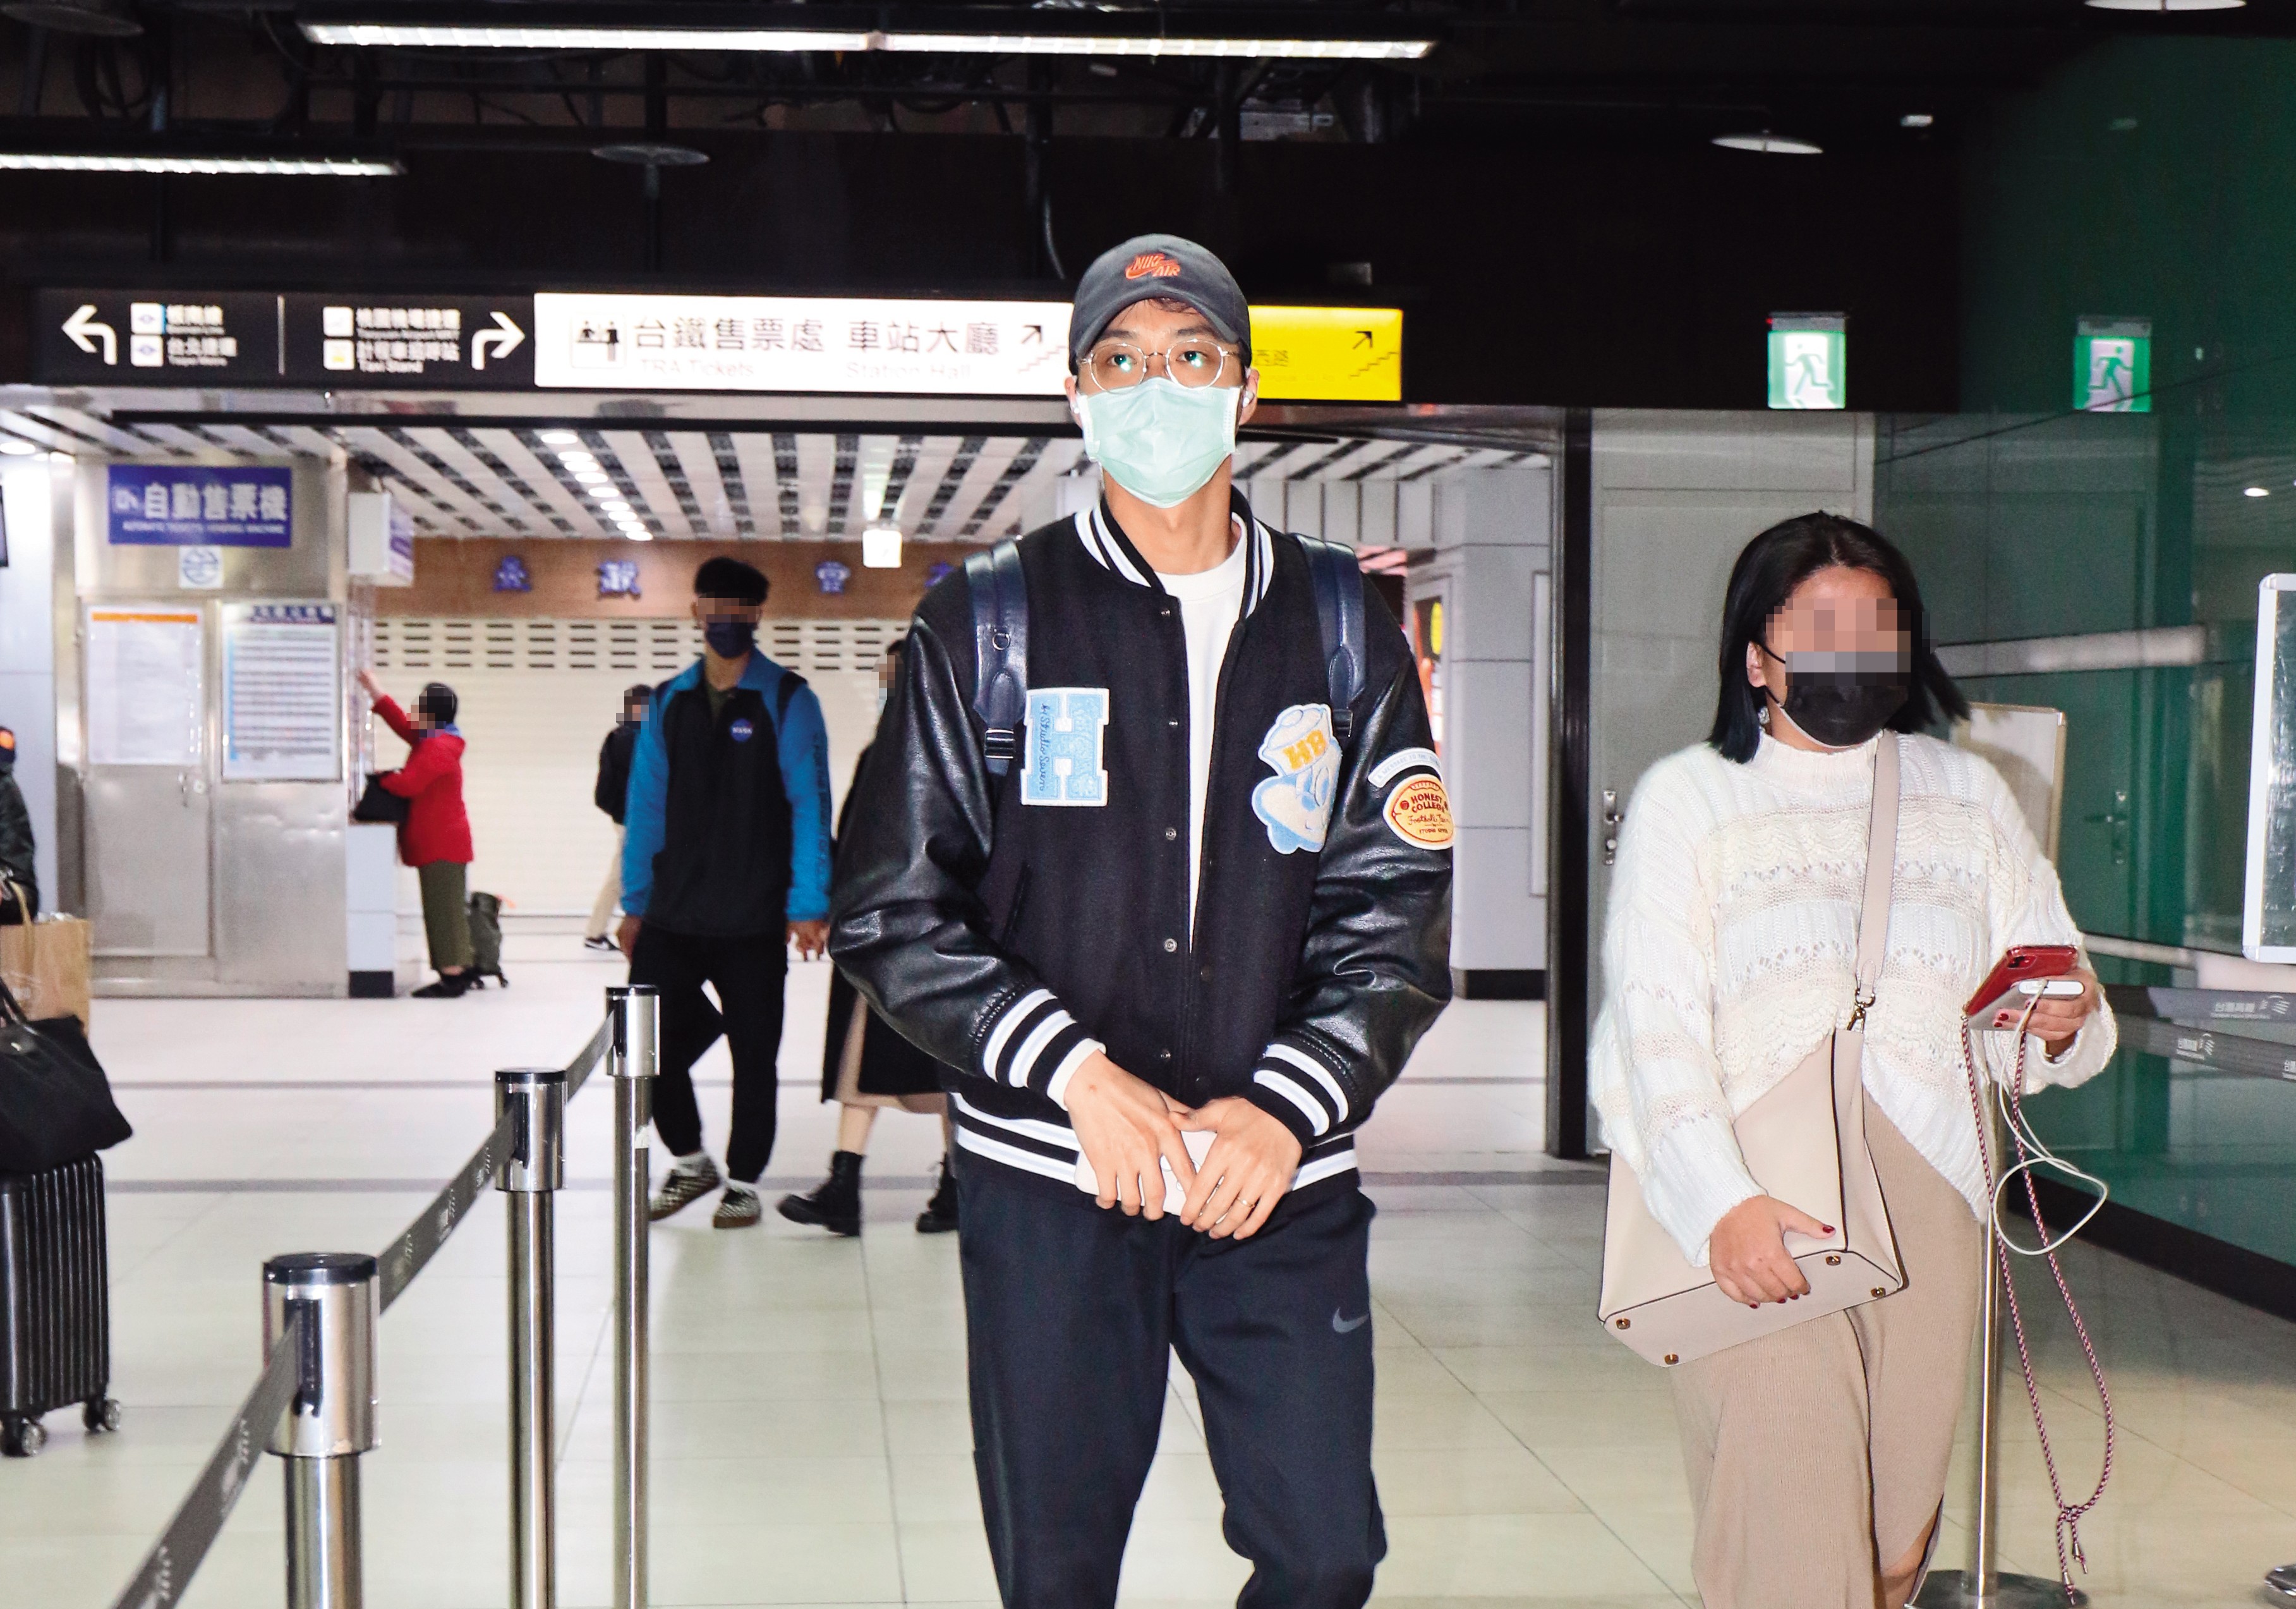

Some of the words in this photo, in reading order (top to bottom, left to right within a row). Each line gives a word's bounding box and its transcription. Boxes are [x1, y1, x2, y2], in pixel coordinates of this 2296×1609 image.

[1132, 255, 1162, 270] NIKE
[1152, 265, 1180, 277] AIR
[634, 316, 824, 351] 台鐵售票處
[848, 320, 998, 355] 車站大廳
[640, 358, 680, 373] TRA
[689, 358, 754, 377] Tickets
[847, 361, 920, 378] Station
[931, 363, 970, 379] Hall
[144, 482, 287, 521] 自動售票機
[1040, 717, 1051, 755] Studio
[1039, 756, 1049, 791] Seven
[1410, 792, 1442, 804] HONEST
[1411, 801, 1445, 813] COLLEGE
[1408, 814, 1438, 825] Football
